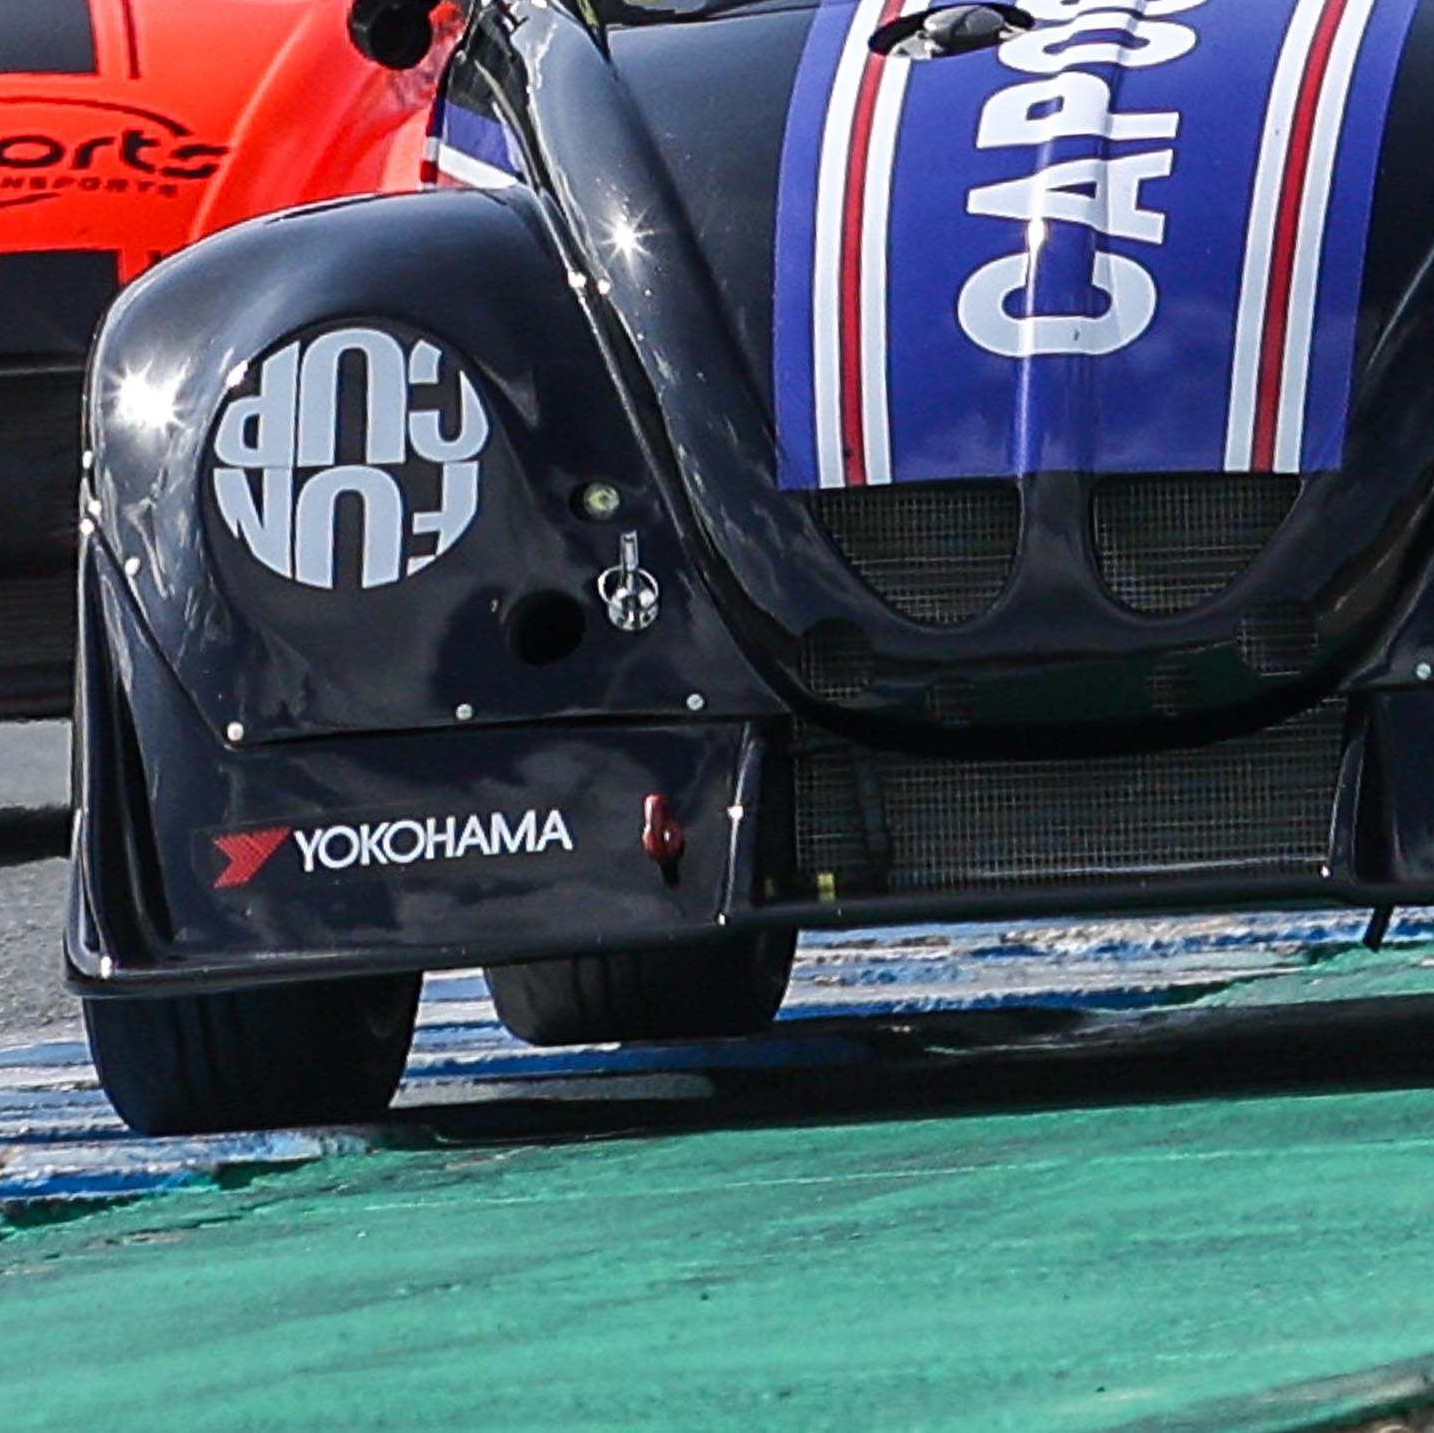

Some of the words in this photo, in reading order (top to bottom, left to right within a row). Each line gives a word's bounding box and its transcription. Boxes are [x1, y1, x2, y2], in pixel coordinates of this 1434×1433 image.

[213, 326, 490, 468] CUP
[212, 463, 480, 590] FUN
[292, 808, 574, 873] YOKOHAMA
